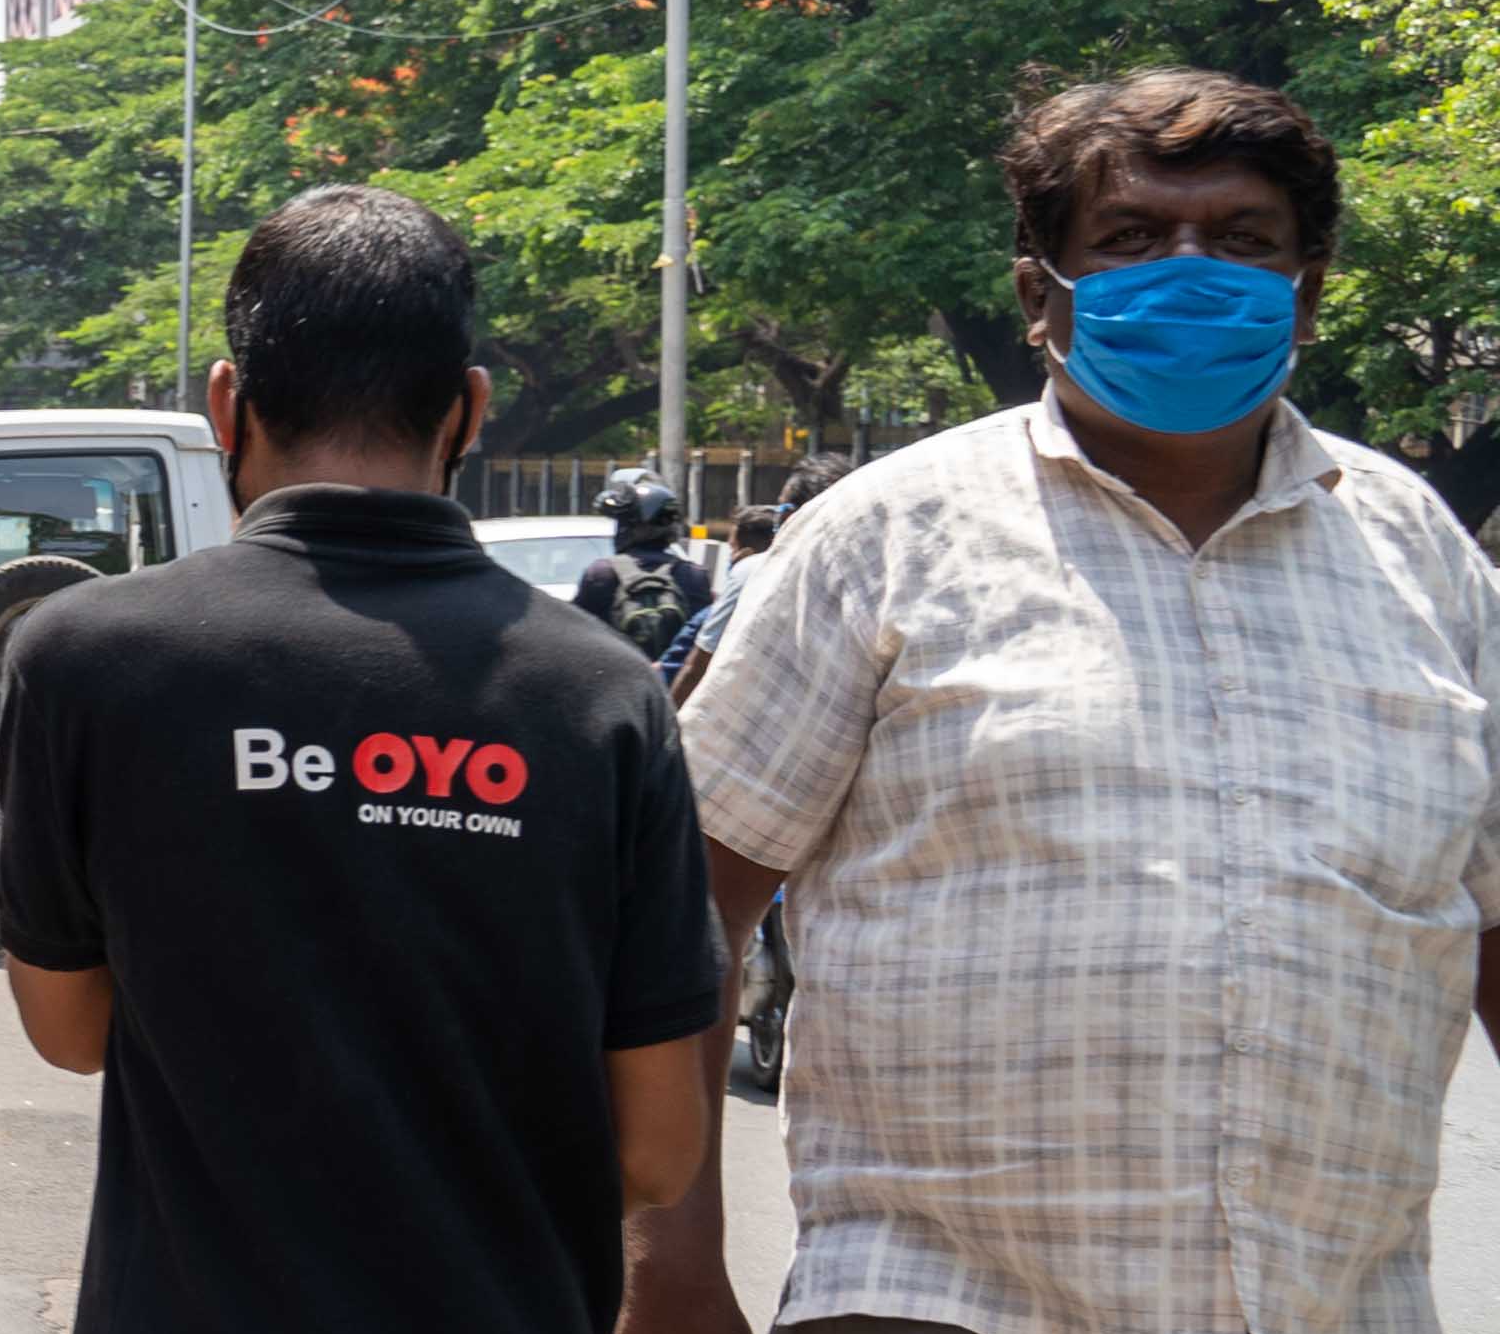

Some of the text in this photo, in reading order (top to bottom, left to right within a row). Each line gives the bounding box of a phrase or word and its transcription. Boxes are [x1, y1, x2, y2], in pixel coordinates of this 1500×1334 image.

[232, 728, 529, 805] Be OYO
[358, 803, 521, 838] ON YOUR OWN
